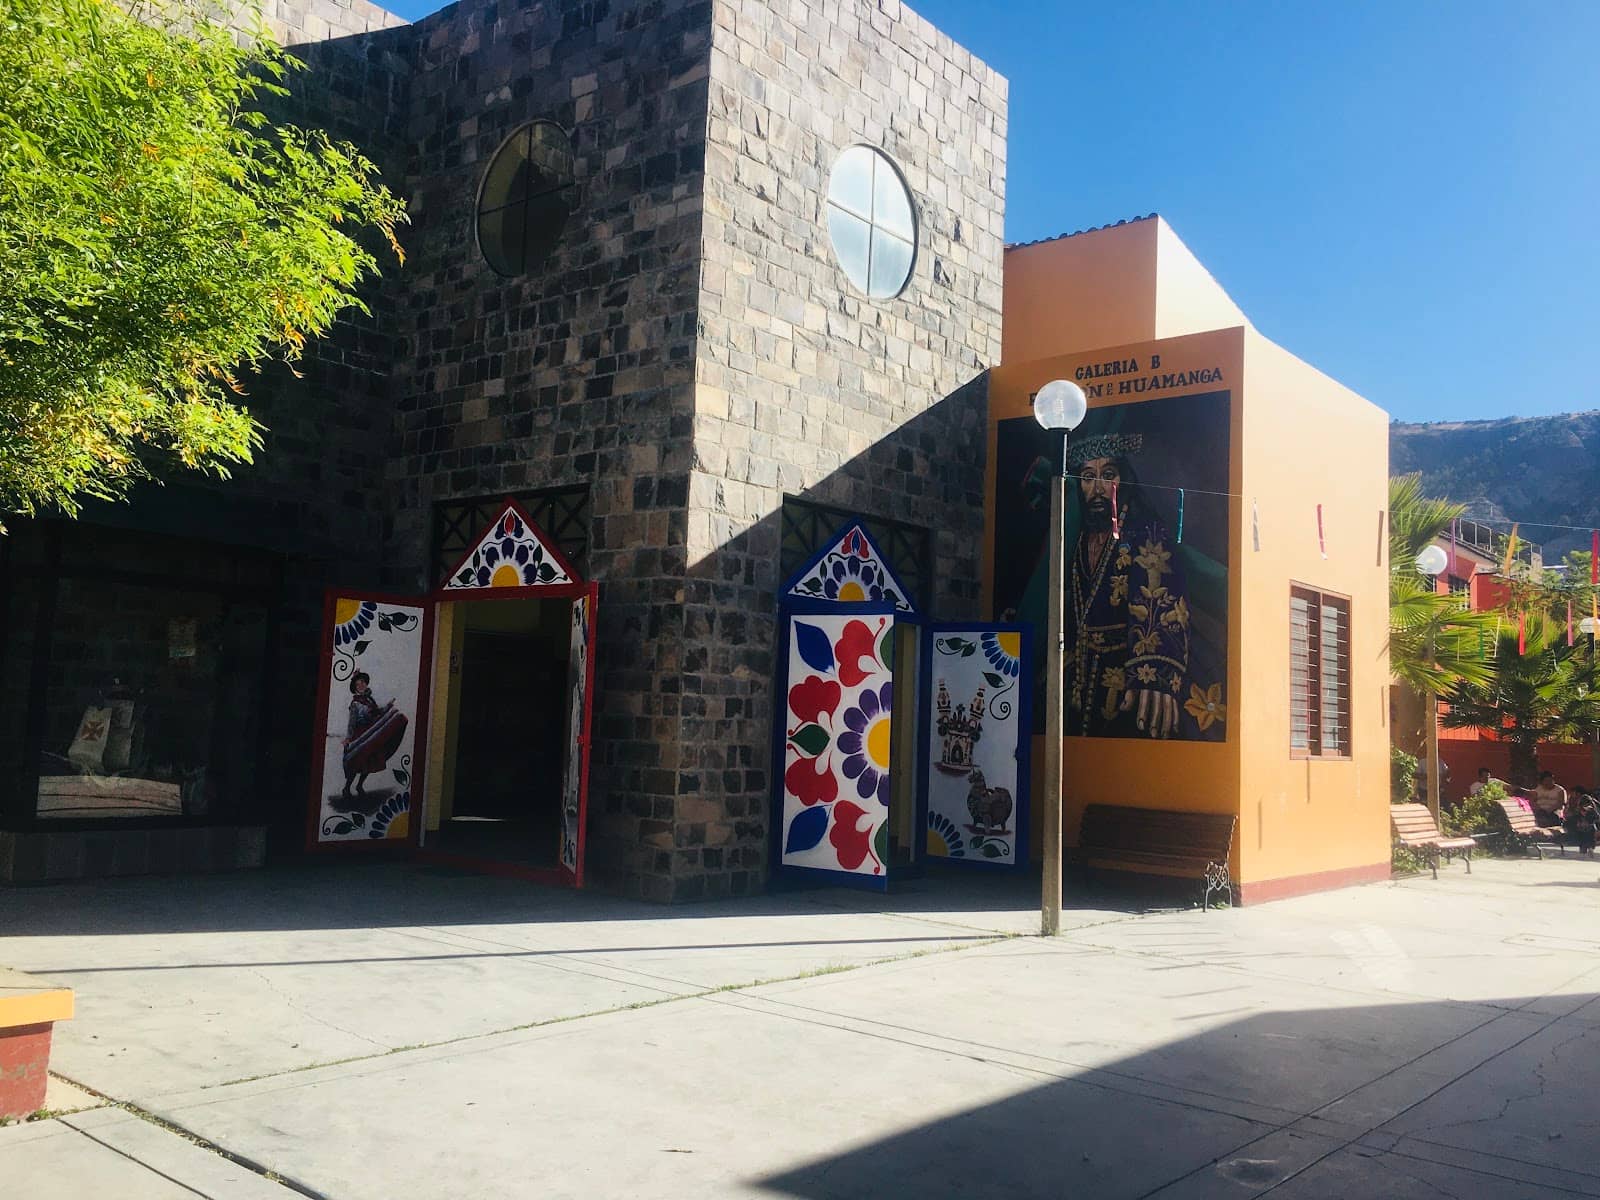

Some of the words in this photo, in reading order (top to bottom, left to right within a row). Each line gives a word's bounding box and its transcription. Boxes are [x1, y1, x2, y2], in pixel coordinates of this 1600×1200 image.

[1075, 358, 1139, 380] GALERIA
[1151, 355, 1161, 369] B
[1119, 368, 1223, 394] HUAMANGA
